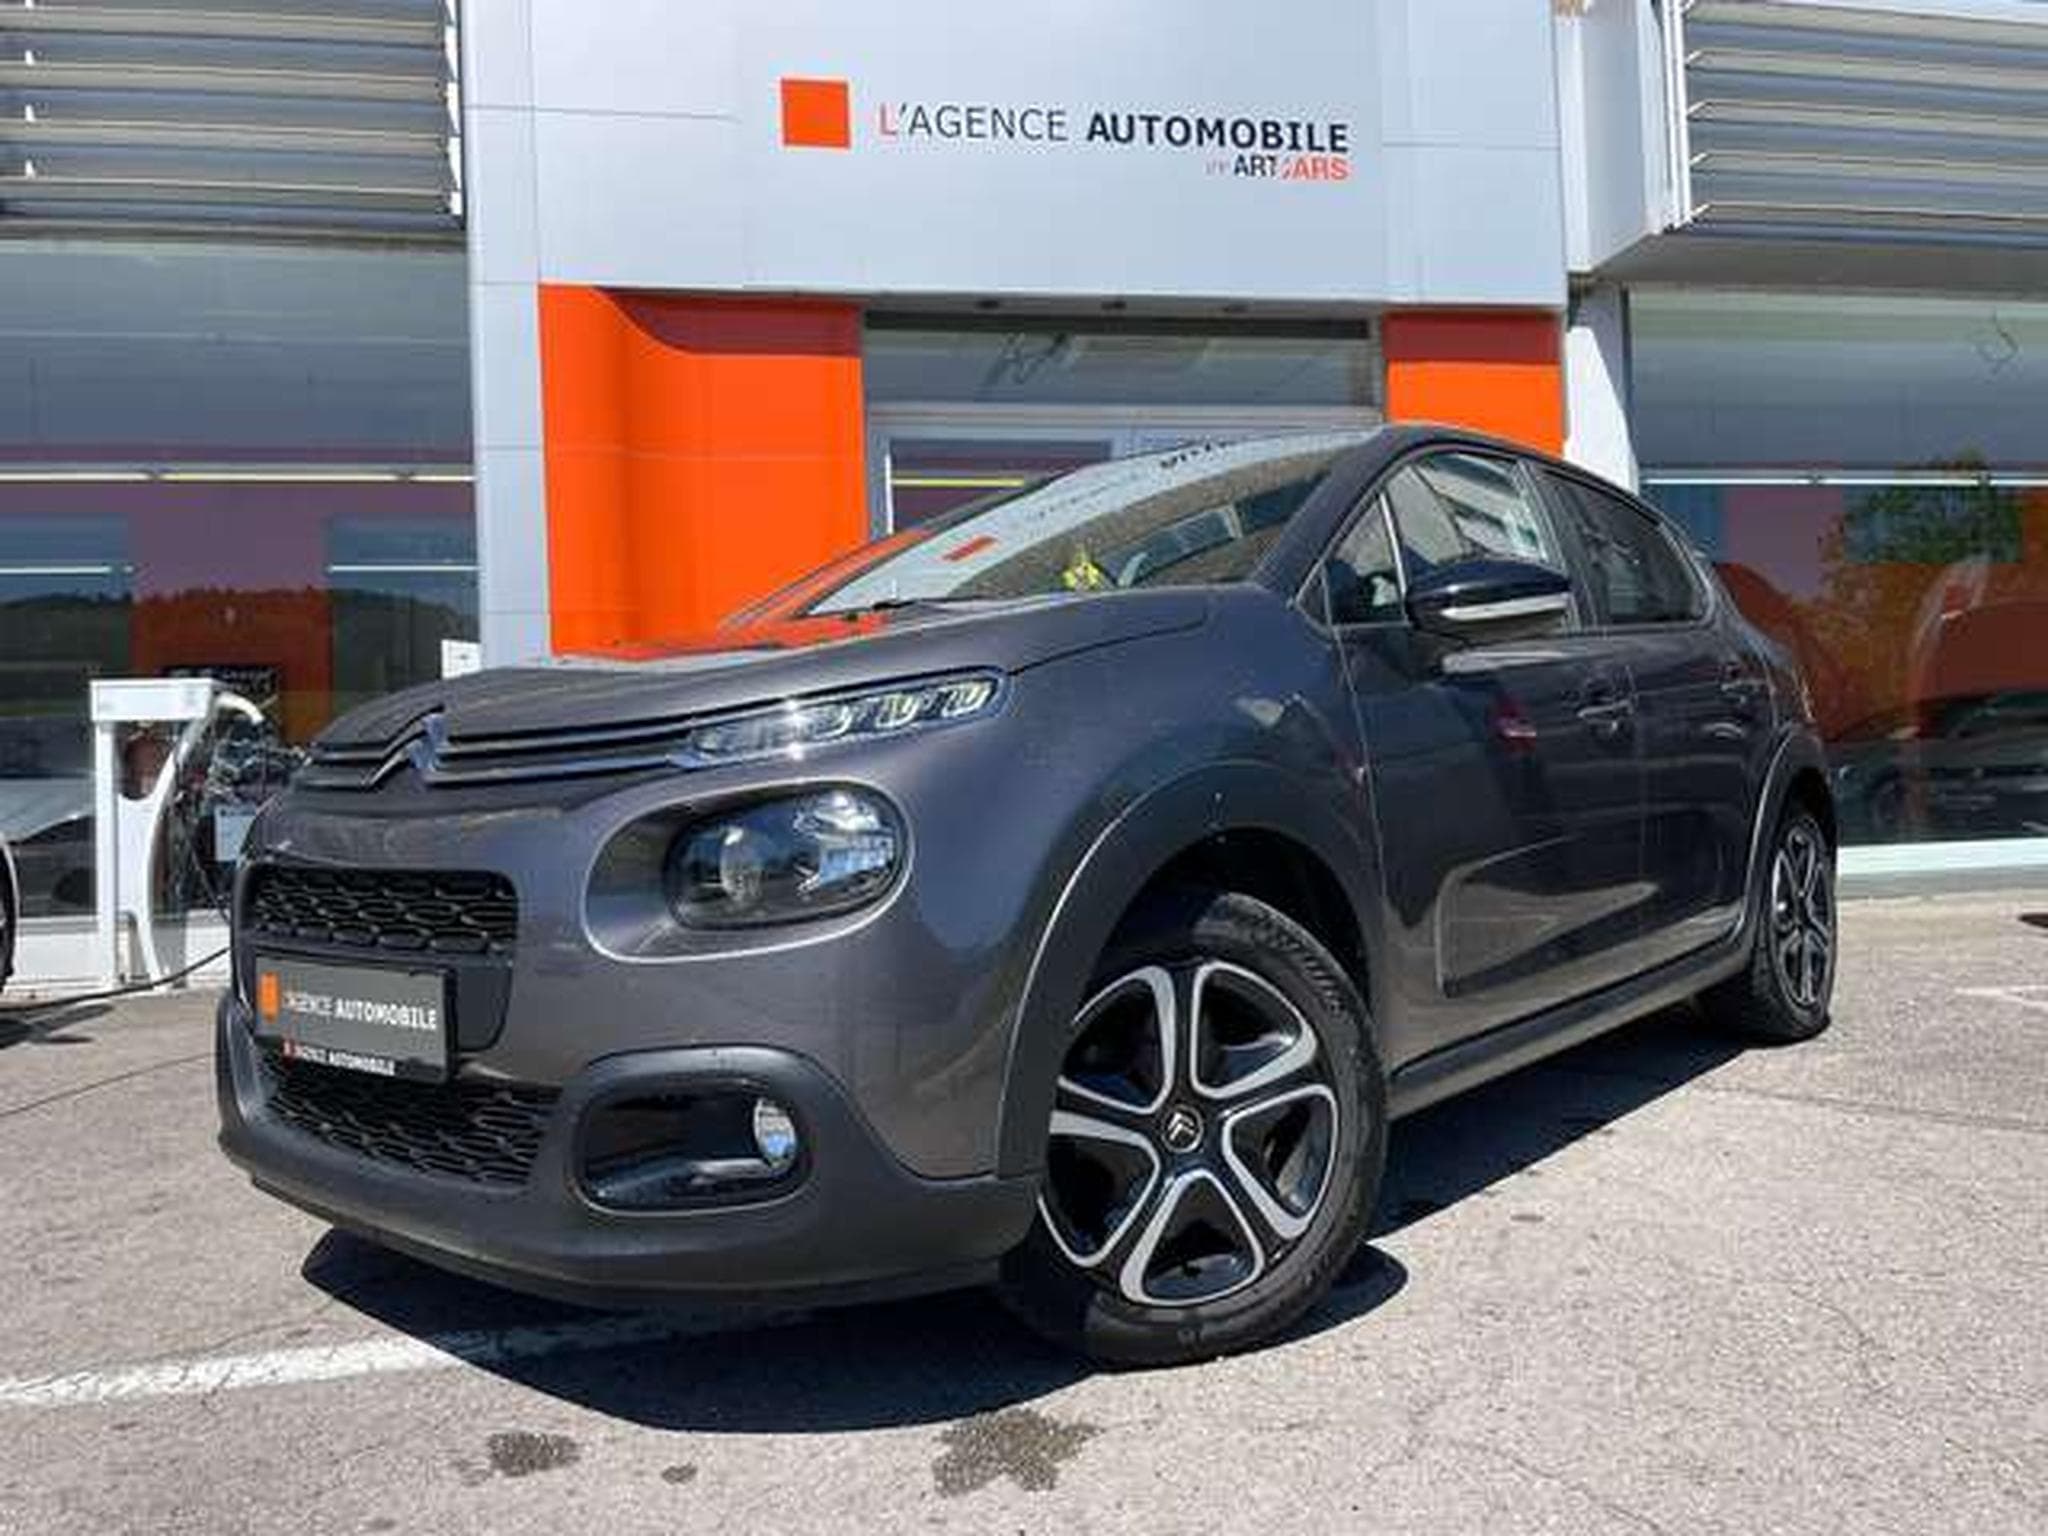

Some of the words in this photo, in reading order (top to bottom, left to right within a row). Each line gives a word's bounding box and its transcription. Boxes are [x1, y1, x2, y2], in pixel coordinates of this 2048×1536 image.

[879, 103, 1069, 142] L'AGENCE
[1086, 112, 1349, 152] AUTOMOBILE
[334, 998, 438, 1030] AUTOMOBILE
